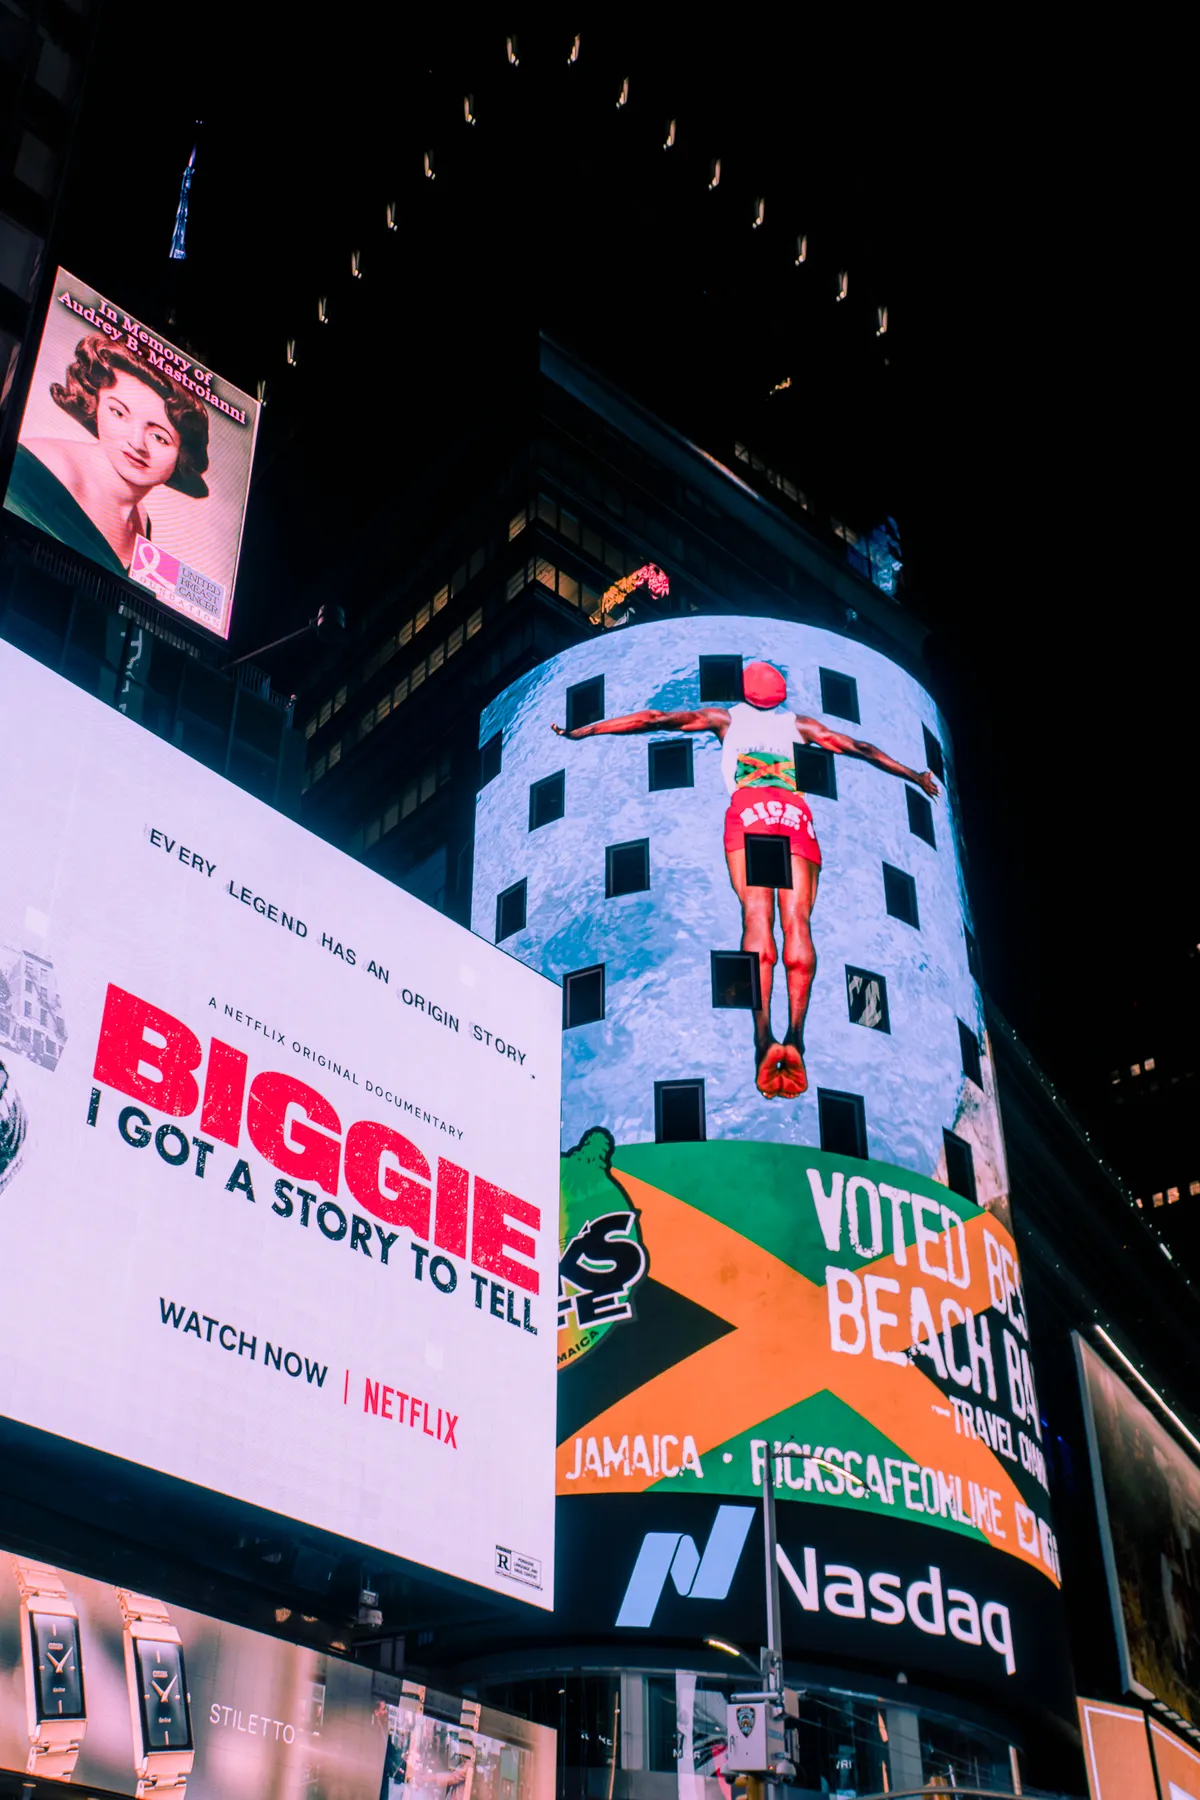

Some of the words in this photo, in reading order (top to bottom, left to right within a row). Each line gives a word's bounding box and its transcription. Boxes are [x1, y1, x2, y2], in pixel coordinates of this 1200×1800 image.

[57, 291, 123, 342] Audrey
[126, 333, 143, 356] B.
[147, 349, 246, 425] Mastroianni
[98, 299, 118, 324] In
[121, 315, 192, 372] Memory
[194, 368, 214, 387] of
[131, 570, 221, 627] FOUNDATION
[178, 586, 218, 615] CANCER
[180, 577, 220, 604] BREAST
[182, 567, 220, 596] UNITED
[149, 828, 217, 878] EVERY
[228, 880, 308, 938] LEGEND
[321, 932, 357, 966] HAS
[366, 960, 390, 984] AN
[401, 989, 460, 1033] ORIGIN
[208, 997, 217, 1009] A
[224, 1004, 286, 1046] NETFLIX
[291, 1041, 359, 1085] ORIGINAL
[365, 1080, 465, 1141] DOCUMENTARY
[93, 982, 541, 1296] BIGGIE
[86, 1086, 102, 1128] I
[118, 1106, 214, 1179] GOT
[224, 1158, 256, 1204] A
[270, 1177, 399, 1266] STORY
[409, 1240, 458, 1294] TO
[470, 1271, 539, 1336] TELL
[805, 1167, 971, 1291] VOTED
[982, 1227, 1029, 1342] BES
[159, 1296, 257, 1361] WATCH
[264, 1341, 329, 1389] NOW
[824, 1265, 998, 1402] BEACH
[1002, 1327, 1042, 1444] BA
[363, 1377, 459, 1451] NETFLIX
[565, 1433, 704, 1483] JAMAICA
[749, 1438, 1007, 1541] RICKSCAFEONLINE
[496, 1551, 511, 1572] R
[774, 1543, 1017, 1676] Nasdaq
[208, 1702, 296, 1745] STILETTO
